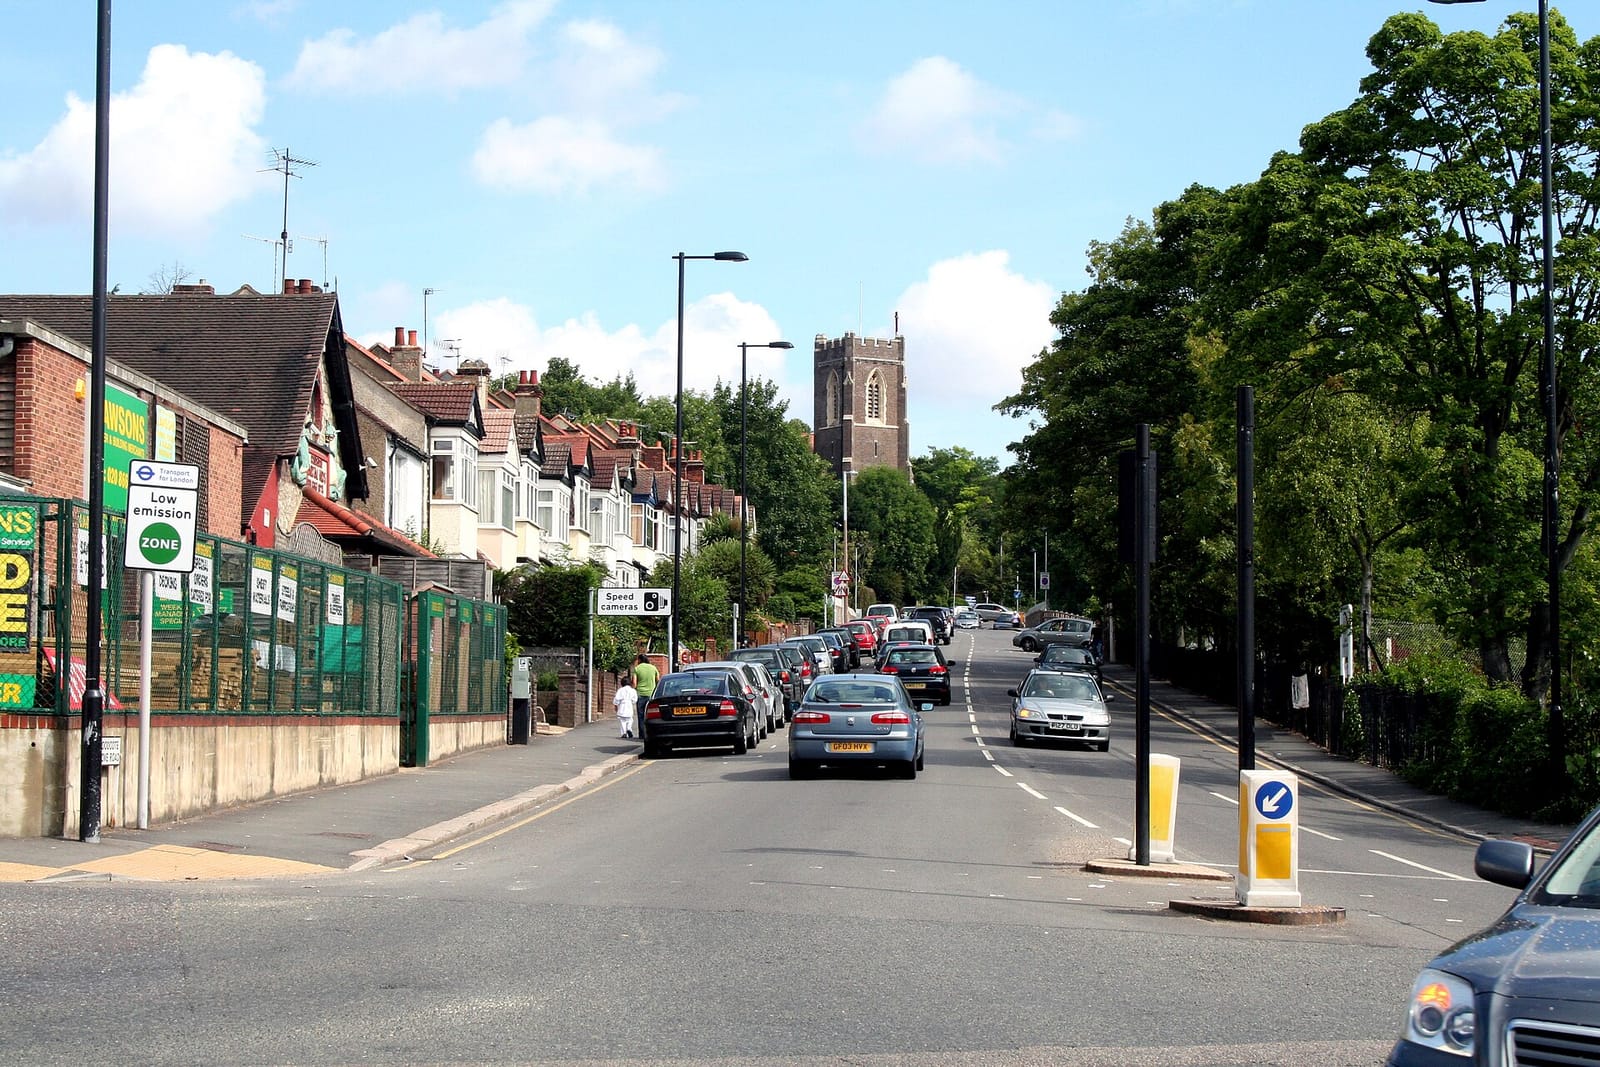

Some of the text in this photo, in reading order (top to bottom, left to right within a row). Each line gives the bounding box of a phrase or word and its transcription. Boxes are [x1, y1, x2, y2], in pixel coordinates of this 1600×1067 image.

[160, 468, 190, 477] Transport
[170, 476, 194, 484] London
[151, 492, 177, 504] Low
[133, 506, 192, 520] emission
[141, 537, 179, 550] ZONE
[606, 592, 634, 601] Speed
